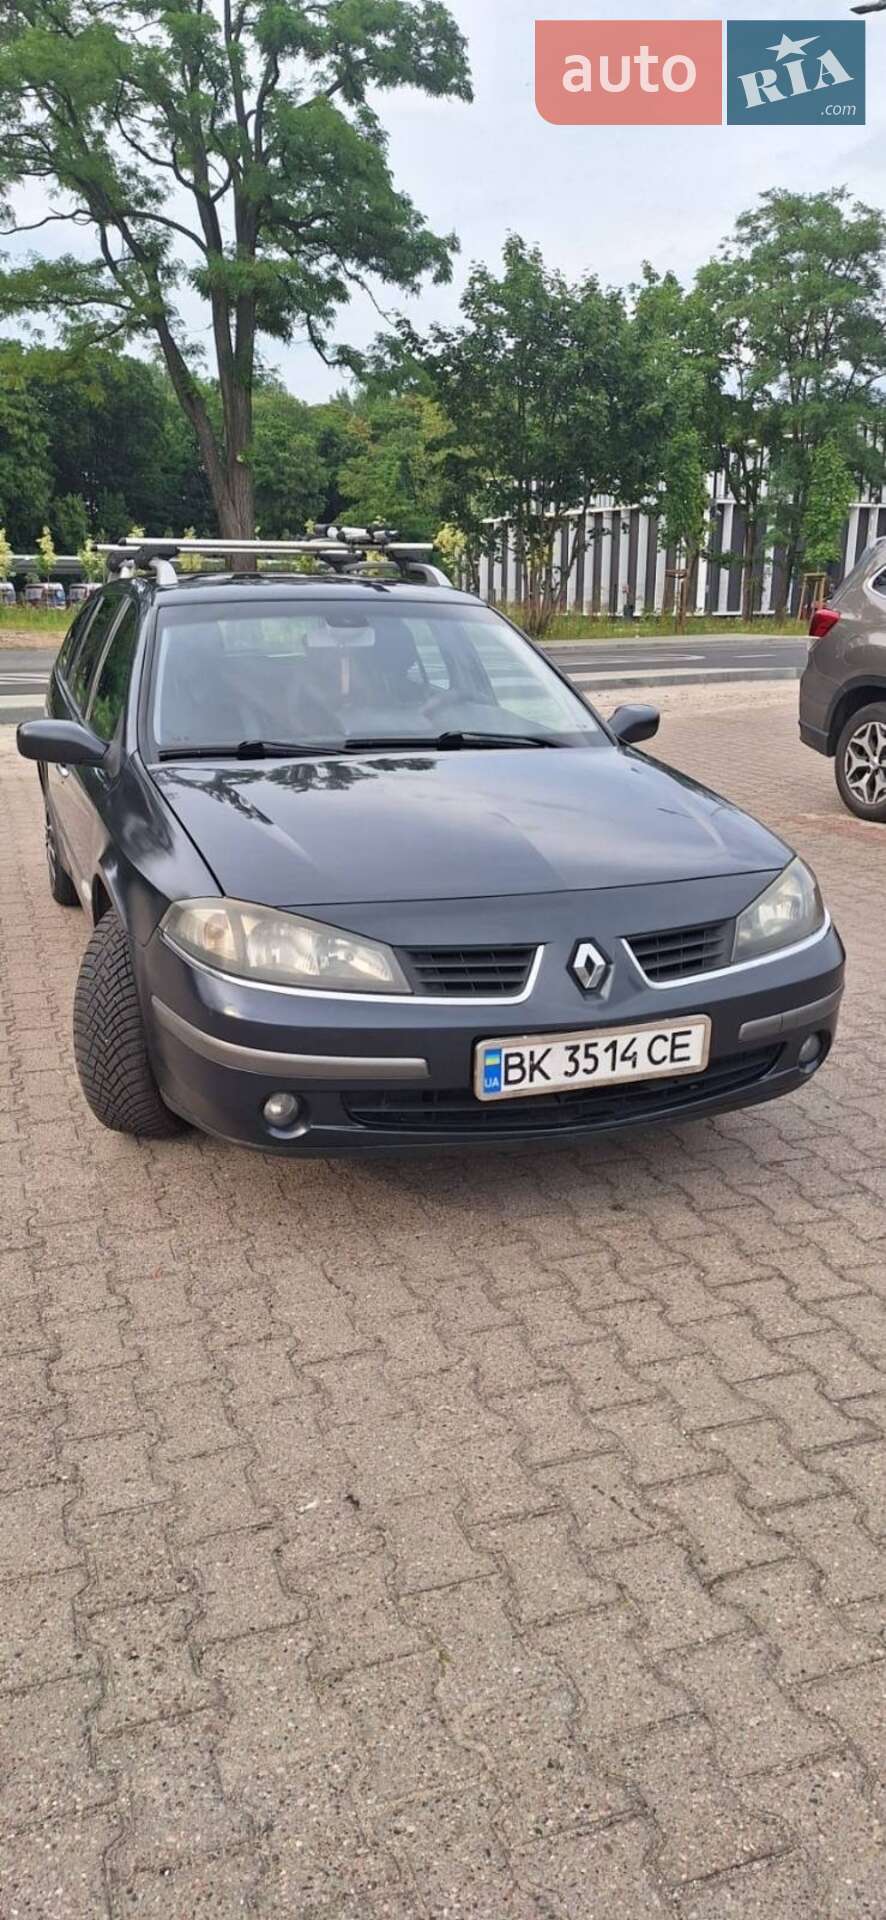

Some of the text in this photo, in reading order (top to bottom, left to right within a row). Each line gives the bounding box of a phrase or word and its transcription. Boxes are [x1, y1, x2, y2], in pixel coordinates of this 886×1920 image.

[503, 1030, 692, 1086] BK 3514 CE
[484, 1077, 500, 1089] UA
